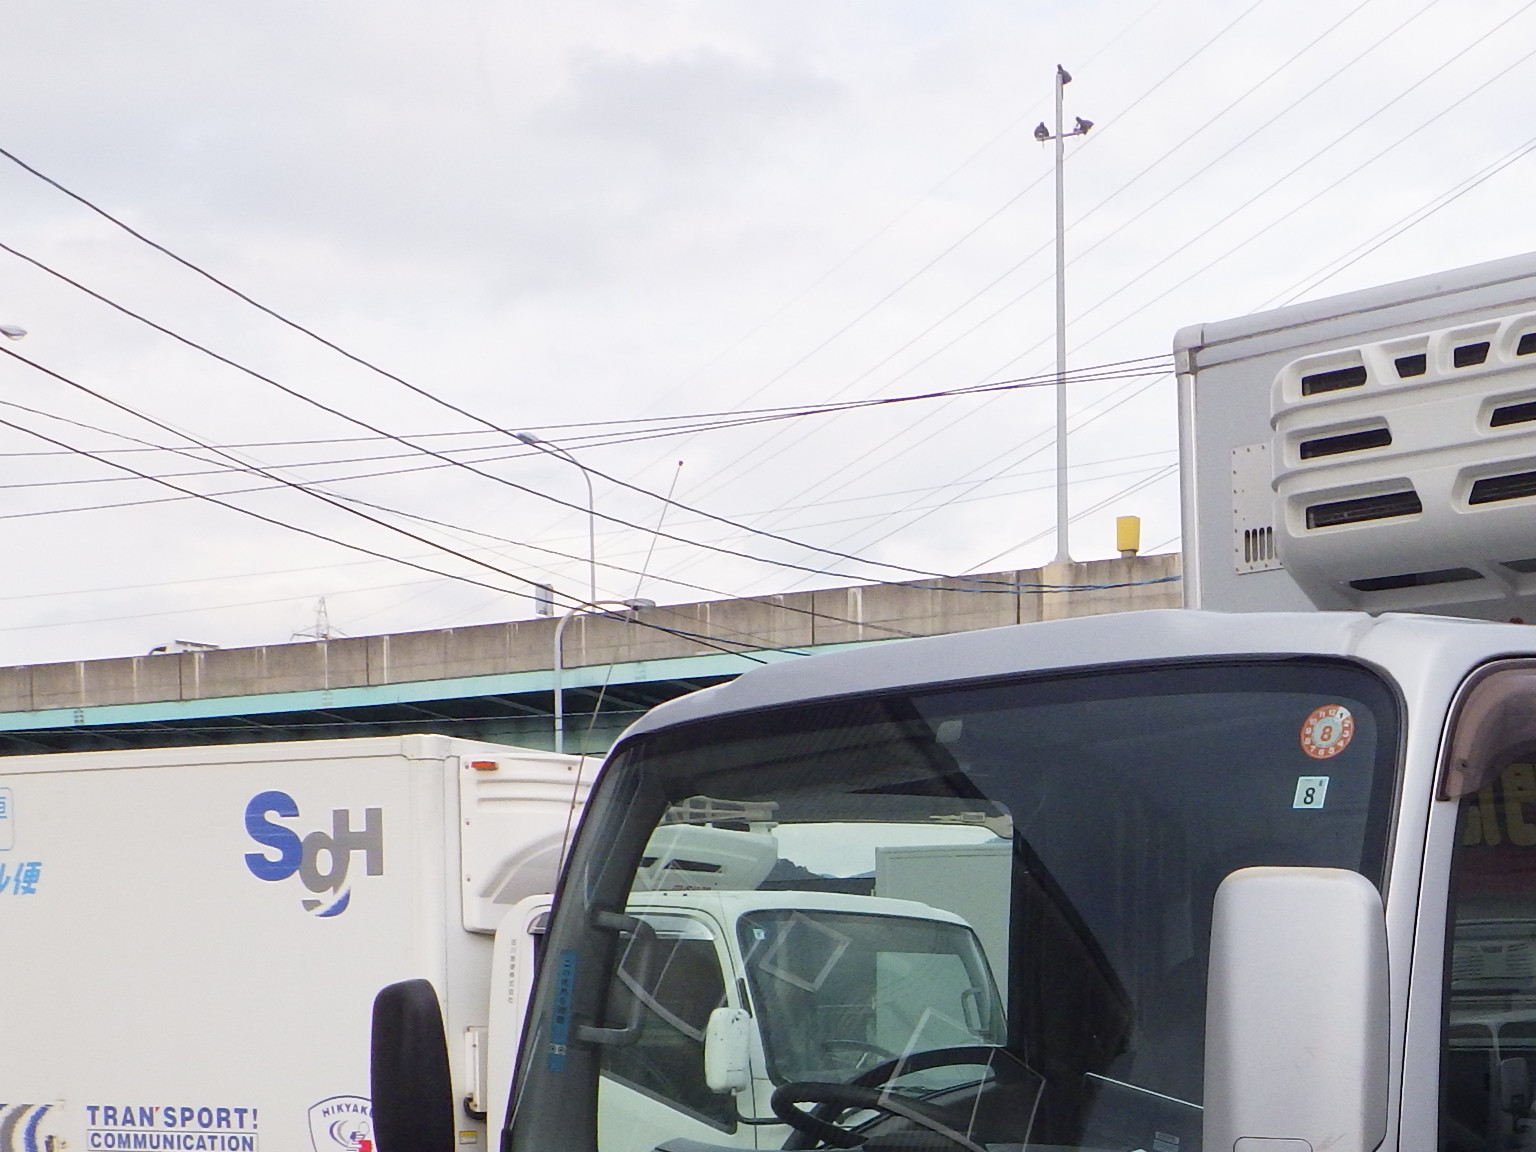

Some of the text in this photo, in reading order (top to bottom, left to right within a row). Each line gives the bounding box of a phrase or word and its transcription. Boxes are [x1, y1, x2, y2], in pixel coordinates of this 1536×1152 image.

[1320, 725, 1333, 742] 8
[1303, 787, 1316, 805] 8
[245, 791, 383, 917] SgH
[90, 1132, 254, 1152] COMMUNICATION
